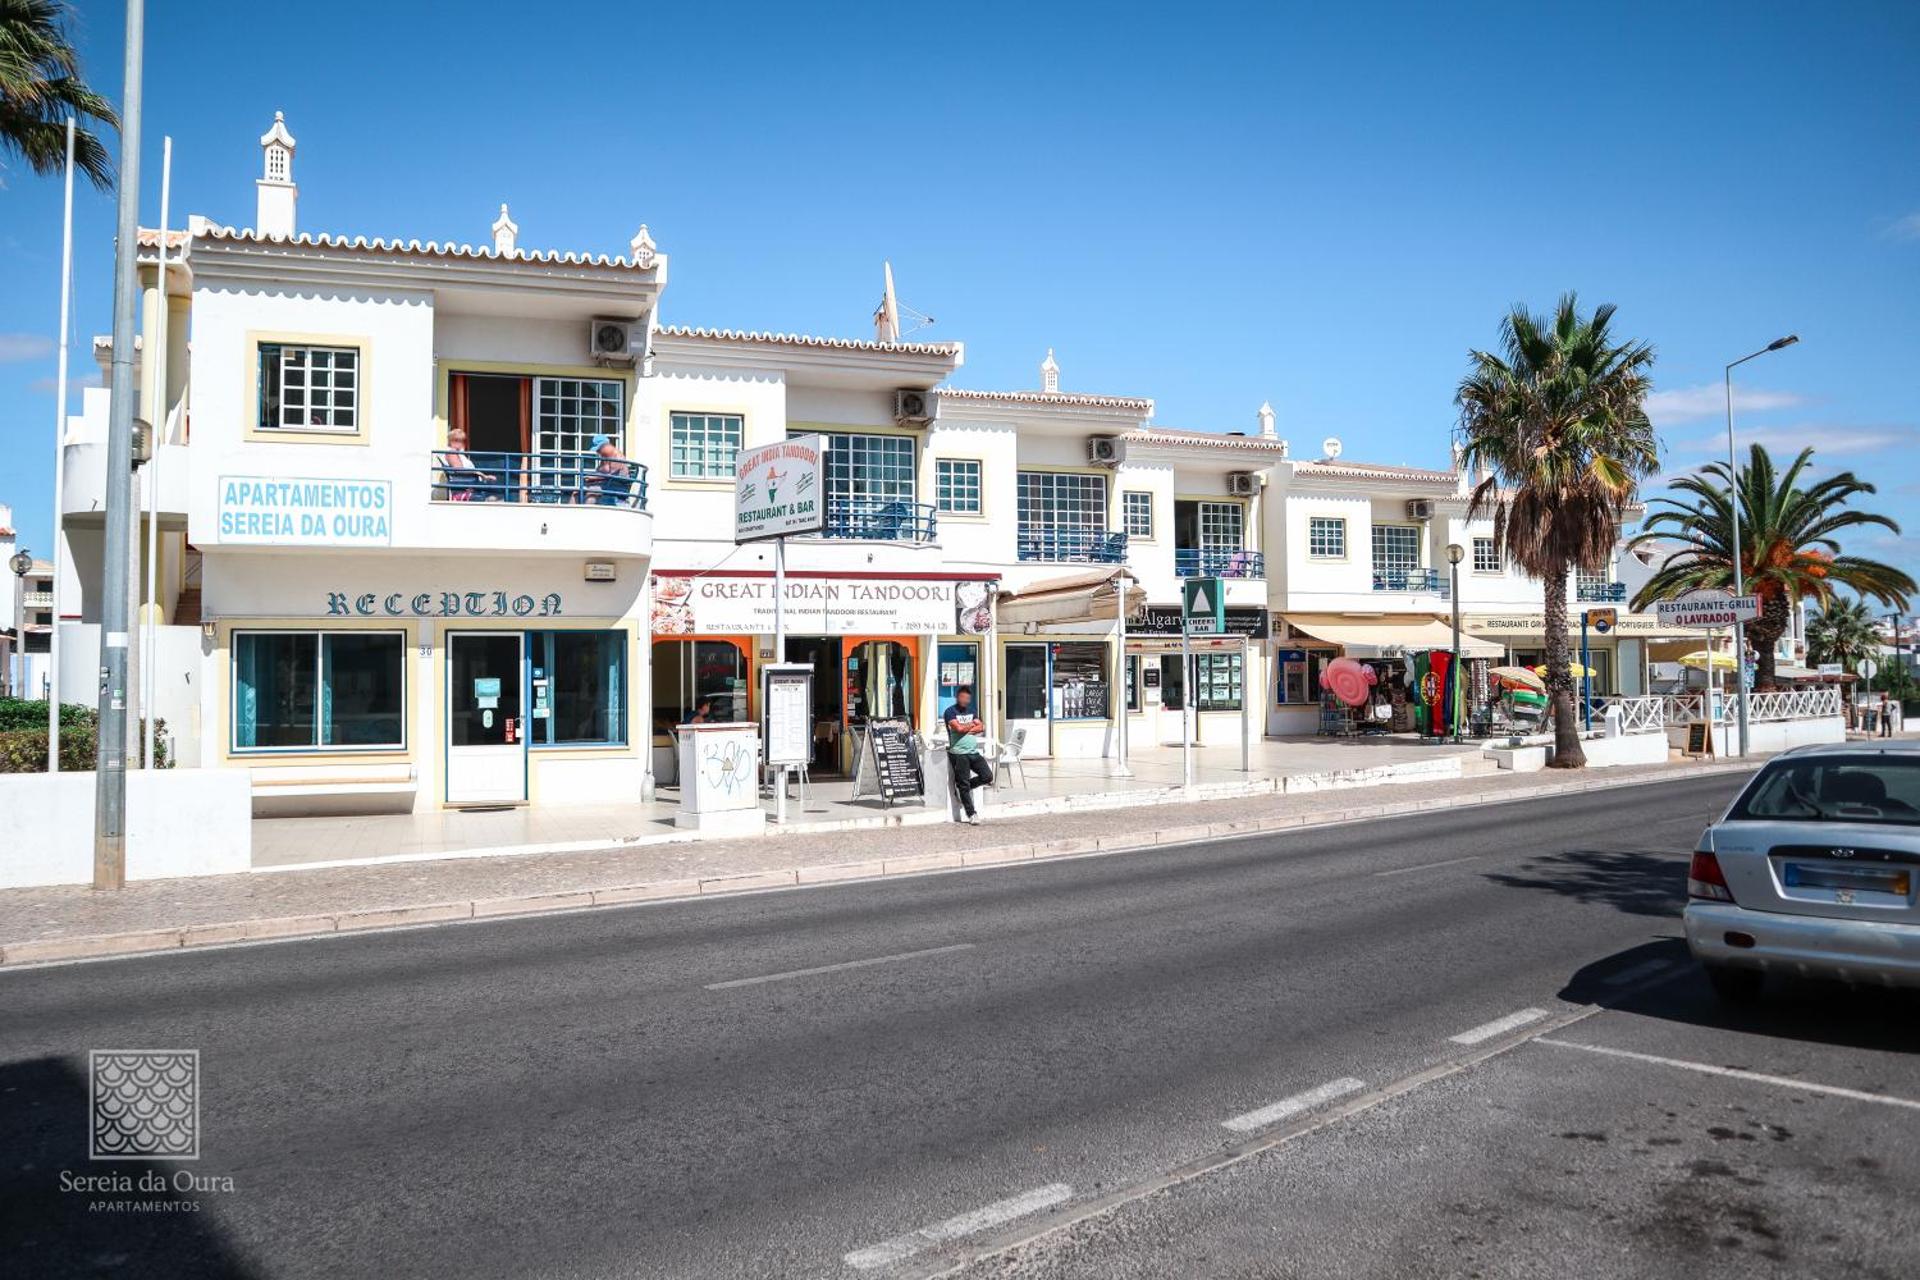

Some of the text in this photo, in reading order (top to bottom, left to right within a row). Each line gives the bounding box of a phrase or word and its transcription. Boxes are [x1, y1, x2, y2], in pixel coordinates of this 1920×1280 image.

[739, 445, 818, 480] GREAT INDIA TANDOORI
[224, 482, 385, 509] APARTAMENTOS
[739, 500, 814, 523] RESTAURANT & BAR
[222, 511, 388, 537] SEREIA DA OURA
[701, 583, 766, 599] GREAT
[848, 584, 951, 601] TANDOORI
[326, 591, 562, 617] RECEPTION
[1659, 599, 1756, 613] RESTAURANTE-GRILL
[1189, 618, 1216, 626] CHEEKS
[1487, 620, 1529, 628] RESTAURANTE
[1676, 612, 1737, 625] O LAVRADOR
[420, 647, 432, 656] 30
